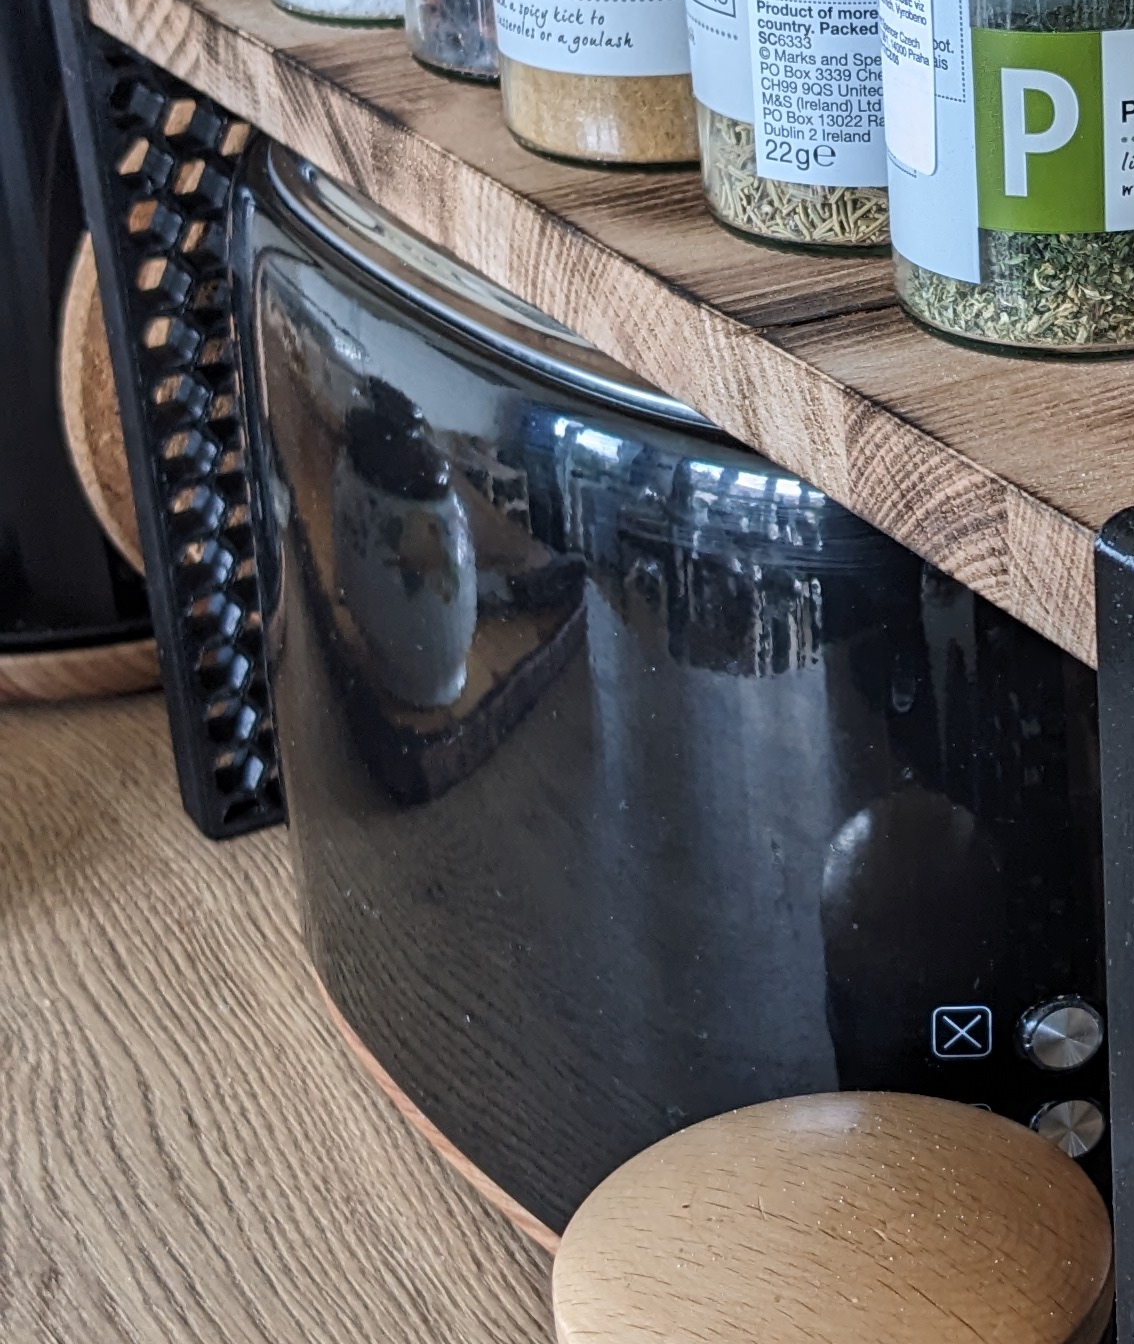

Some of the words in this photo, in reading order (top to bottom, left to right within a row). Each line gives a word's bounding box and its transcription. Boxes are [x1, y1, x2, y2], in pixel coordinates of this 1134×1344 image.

[519, 3, 549, 29] spicy
[553, 6, 585, 25] kick
[590, 10, 605, 26] to
[756, 0, 814, 19] Product
[817, 6, 833, 20] of
[837, 9, 879, 20] more
[757, 18, 815, 37] country.
[819, 21, 879, 36] Packed
[540, 32, 552, 42] or
[558, 36, 568, 44] a
[568, 31, 634, 54] goulash
[758, 31, 812, 50] SC6333
[774, 49, 817, 65] Marks
[820, 53, 848, 67] and
[852, 53, 882, 70] Spe
[760, 61, 780, 77] PO
[784, 65, 812, 81] Box
[815, 68, 852, 82] 3339
[856, 68, 883, 82] Che
[761, 76, 798, 94] CH99
[801, 82, 834, 97] 9QS
[762, 91, 793, 109] M&S
[796, 96, 853, 114] (Ireland)
[858, 99, 882, 113] Ltd
[763, 106, 783, 123] PO
[786, 110, 814, 126] Box
[819, 114, 863, 128] 13022
[867, 114, 885, 128] Ra
[764, 122, 805, 141] Dublin
[808, 128, 818, 142] 2
[822, 129, 871, 143] Ireland
[1000, 67, 1079, 197] P
